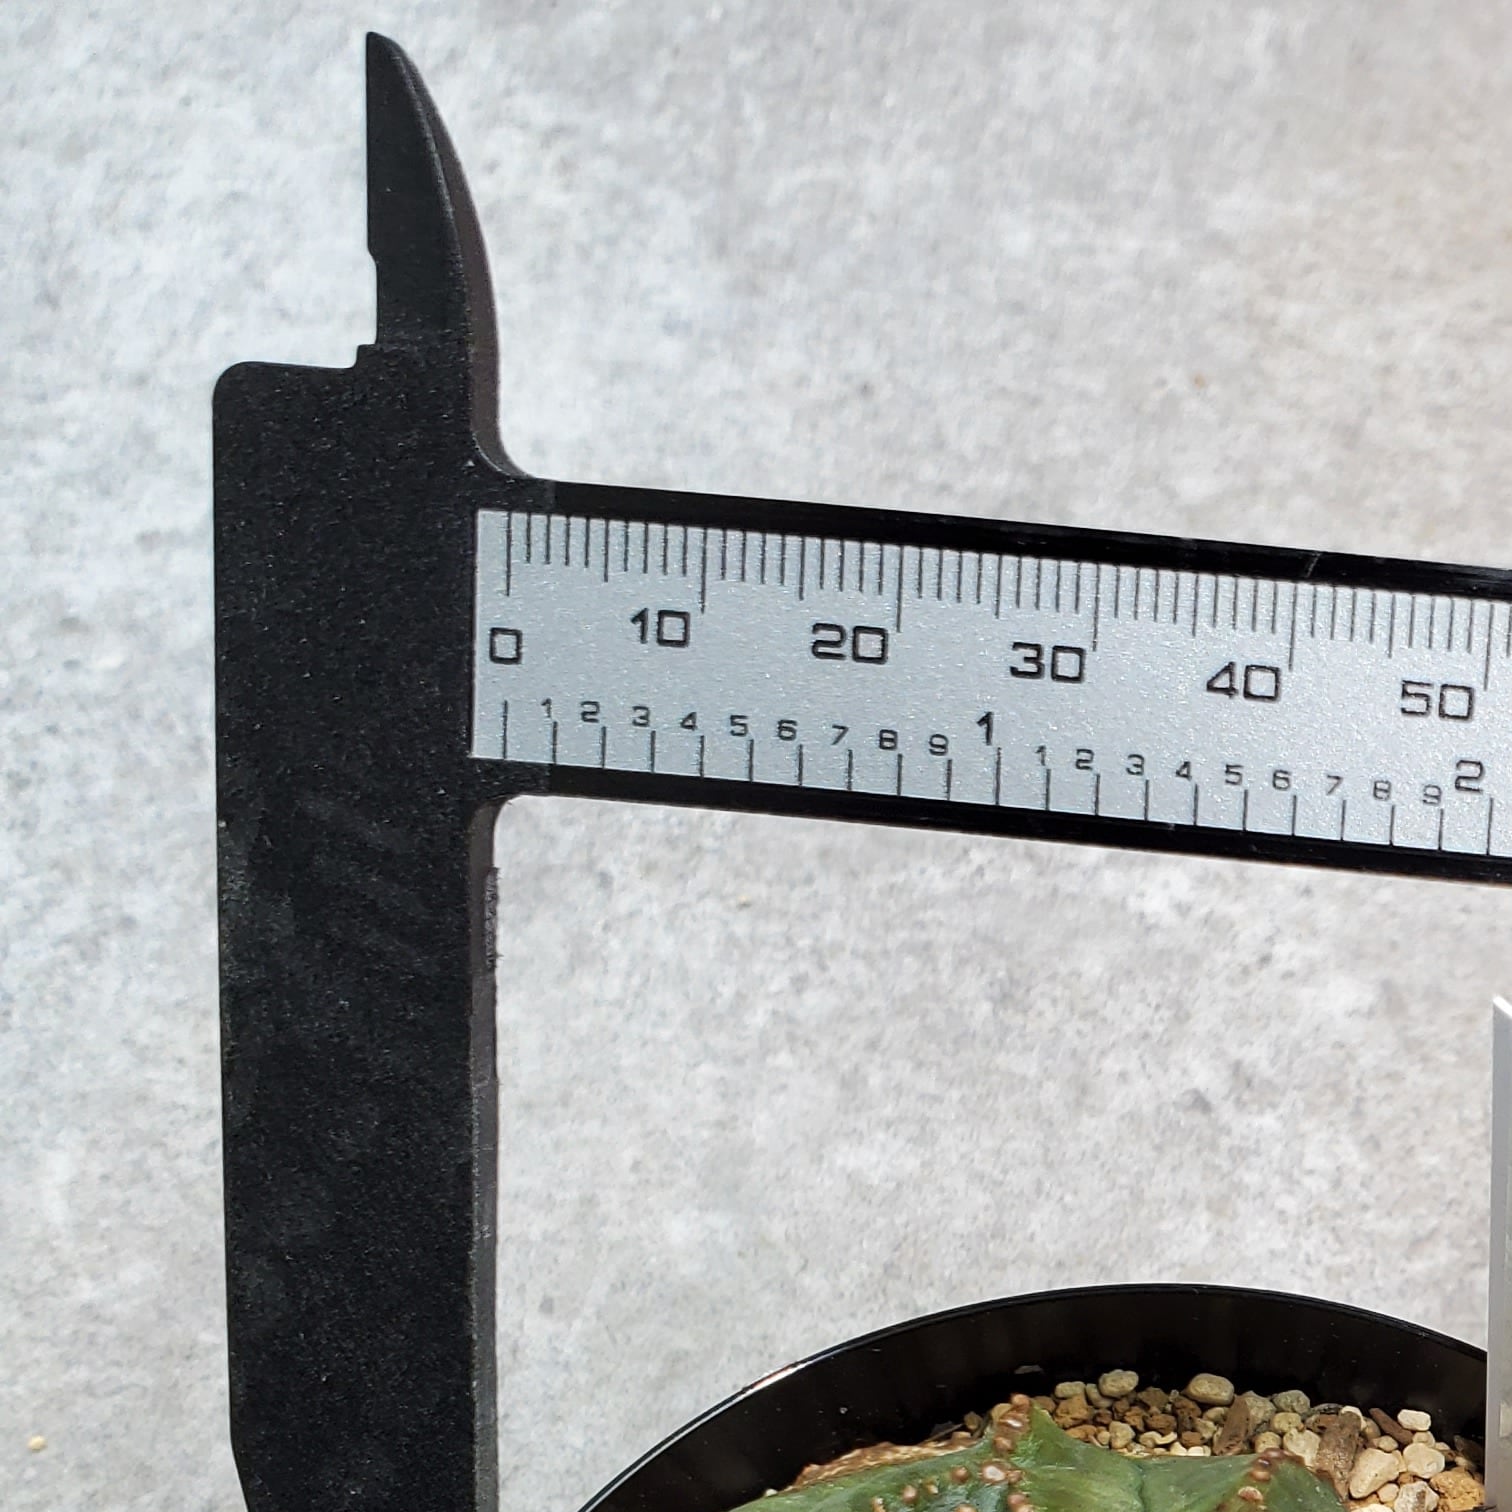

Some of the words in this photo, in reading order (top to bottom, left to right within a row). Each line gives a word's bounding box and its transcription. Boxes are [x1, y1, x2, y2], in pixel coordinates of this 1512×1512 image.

[489, 628, 522, 664] 0
[631, 608, 690, 647] 10
[811, 623, 888, 664] 20
[1010, 641, 1085, 683] 30
[1206, 662, 1281, 700] 40
[1401, 680, 1475, 721] 50
[541, 698, 552, 718] 1
[581, 701, 600, 723] 2
[632, 706, 650, 728] 3
[680, 712, 698, 731] 4
[730, 715, 749, 736] 5
[778, 720, 798, 741] 6
[831, 725, 849, 745] 7
[879, 729, 898, 750] 8
[929, 734, 949, 756] 9
[977, 711, 994, 745] 1
[1035, 746, 1047, 766] 1
[1075, 749, 1094, 770] 2
[1126, 754, 1145, 775] 3
[1176, 761, 1192, 781] 4
[1225, 765, 1243, 785] 5
[1272, 770, 1291, 790] 6
[1326, 775, 1343, 796] 7
[1373, 780, 1391, 800] 8
[1423, 785, 1442, 805] 9
[1455, 760, 1485, 793] 2
